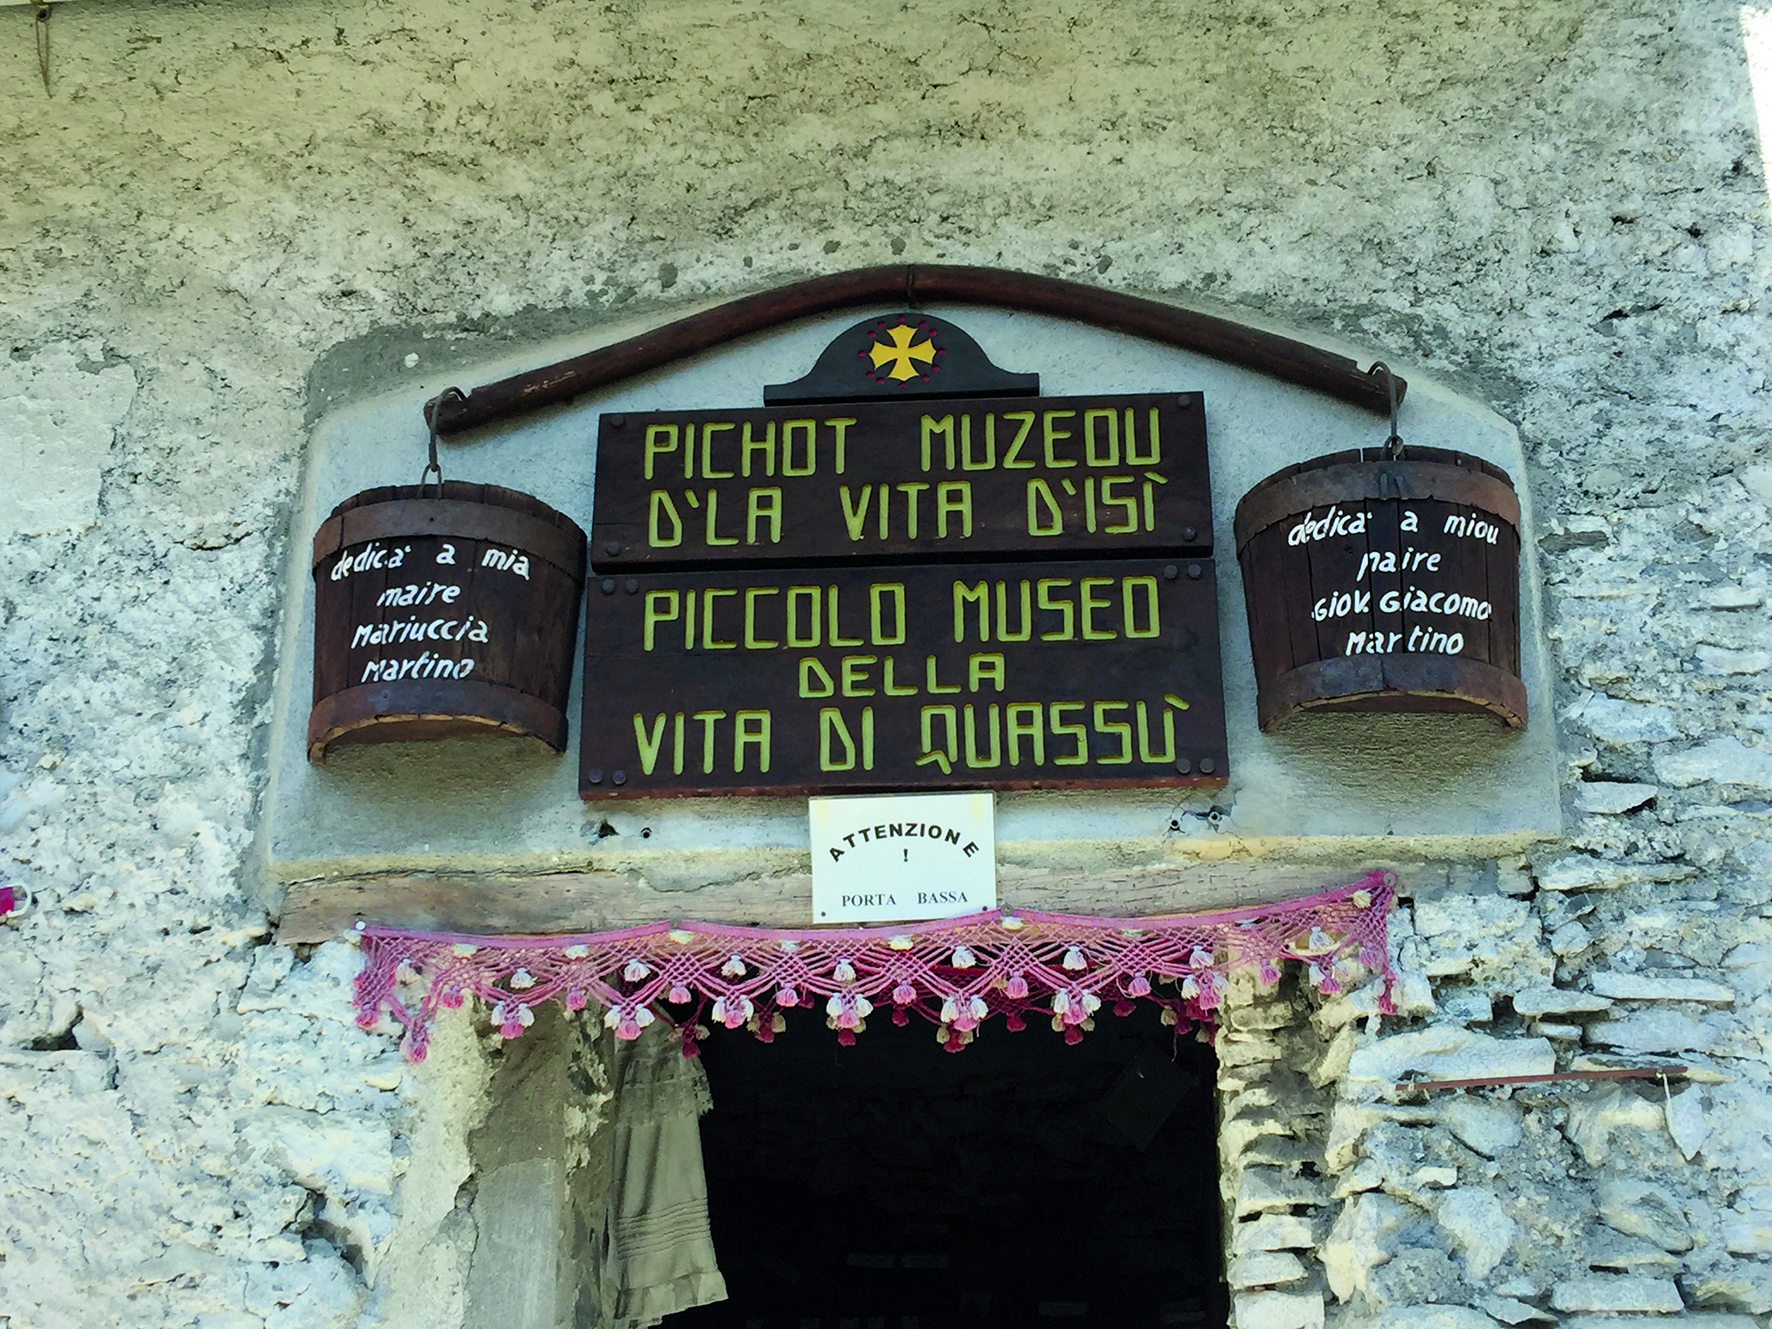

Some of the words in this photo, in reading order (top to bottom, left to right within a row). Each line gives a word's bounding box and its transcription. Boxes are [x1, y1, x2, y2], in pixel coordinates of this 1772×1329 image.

[644, 417, 858, 480] PICHOT
[920, 407, 1162, 473] MUZEOU
[838, 480, 973, 542] VITA
[1399, 510, 1418, 533] a
[1443, 512, 1500, 545] miou
[436, 543, 456, 565] a
[481, 547, 532, 581] mia
[377, 581, 462, 607] maire
[644, 582, 907, 652] PICCOLO
[953, 575, 1161, 643] MUSEO
[799, 652, 1005, 698] DELLA
[633, 709, 772, 776] VITA
[820, 705, 875, 772] DI
[916, 693, 1190, 775] QUASSÙ
[829, 822, 980, 863] ATTENZIONE
[903, 848, 909, 862] !
[842, 893, 897, 907] PORTA
[917, 891, 968, 905] BASSA
